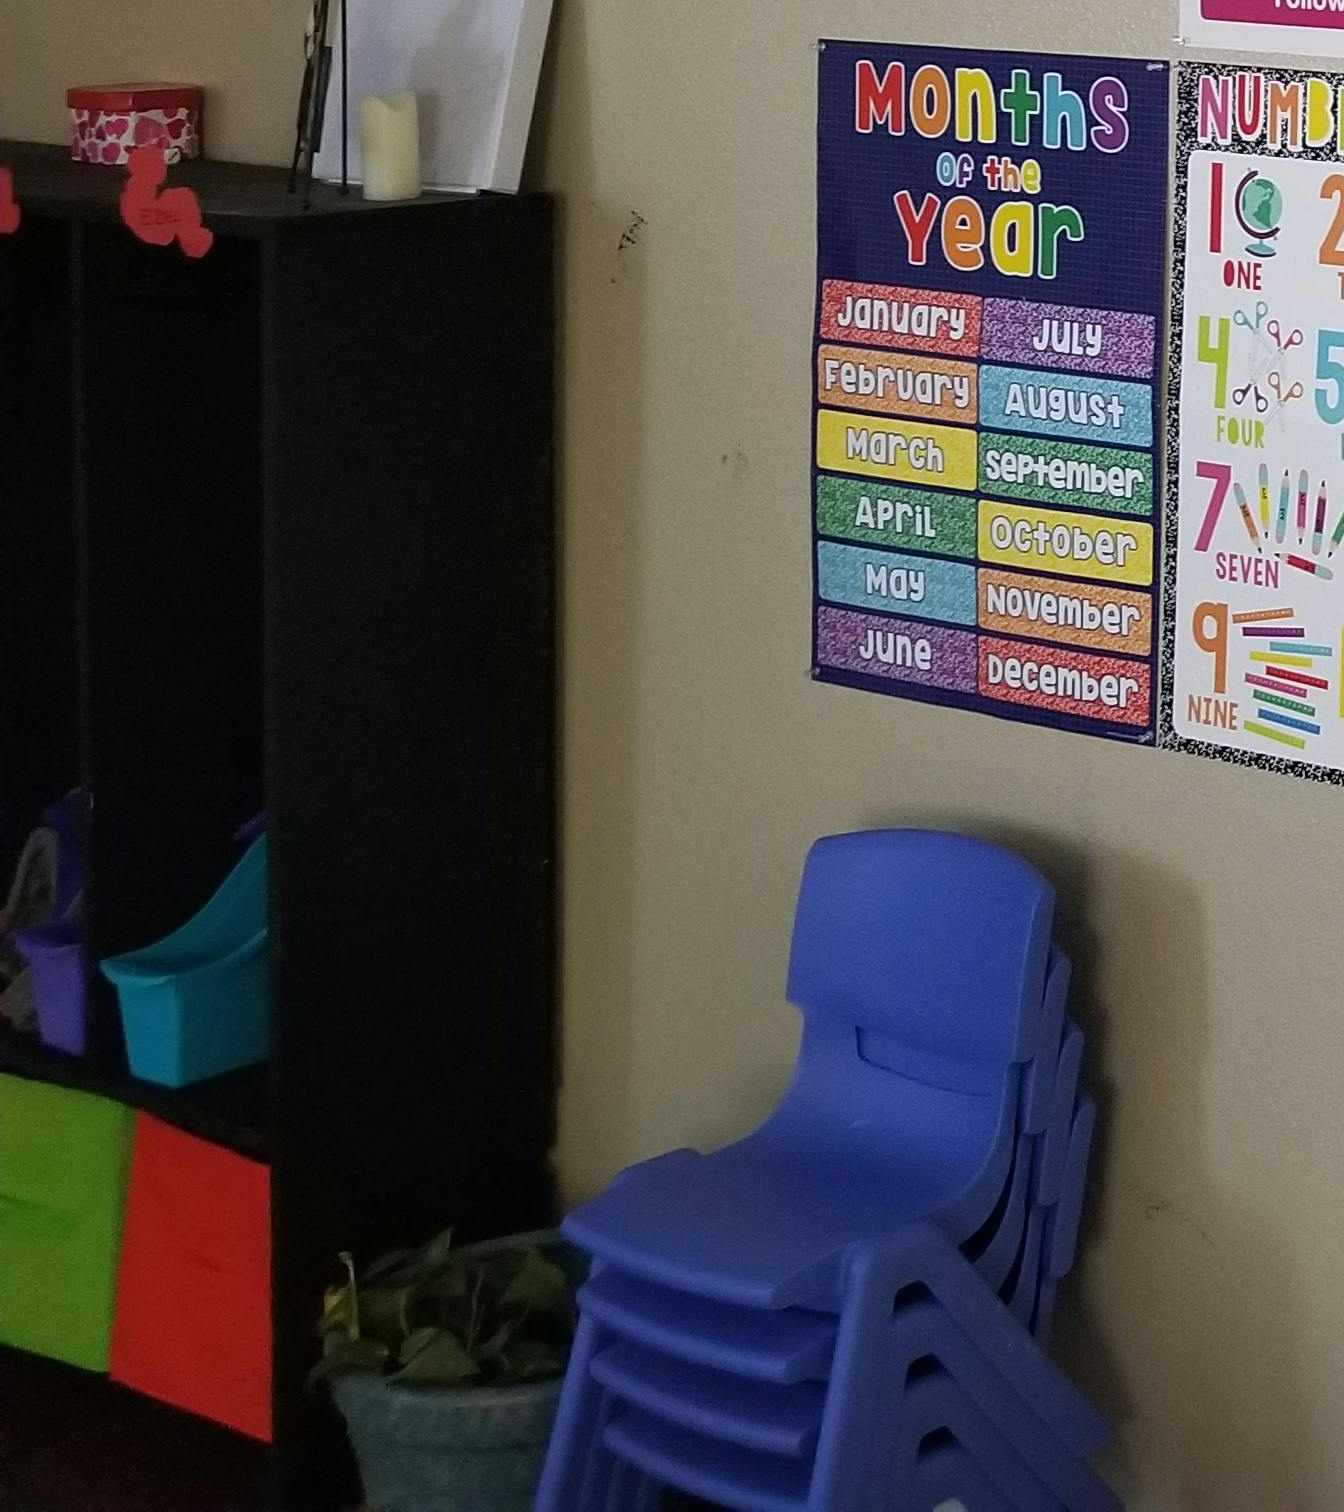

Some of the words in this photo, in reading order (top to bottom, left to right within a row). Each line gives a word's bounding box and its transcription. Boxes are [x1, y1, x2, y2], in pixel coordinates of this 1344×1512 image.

[856, 60, 1129, 153] Months
[983, 156, 1041, 193] the
[894, 190, 1084, 279] Year
[1223, 260, 1262, 290] ONE
[838, 296, 965, 339] January
[825, 359, 969, 408] February
[1004, 384, 1124, 428] August
[847, 427, 944, 472] March
[1217, 415, 1265, 448] FOUR
[986, 449, 1143, 498] September
[991, 516, 1137, 566] October
[866, 564, 925, 602] May
[1216, 552, 1278, 588] SEVEN
[987, 584, 1140, 636] November
[860, 630, 932, 670] June
[988, 657, 1138, 708] December
[1188, 695, 1238, 730] NINE
